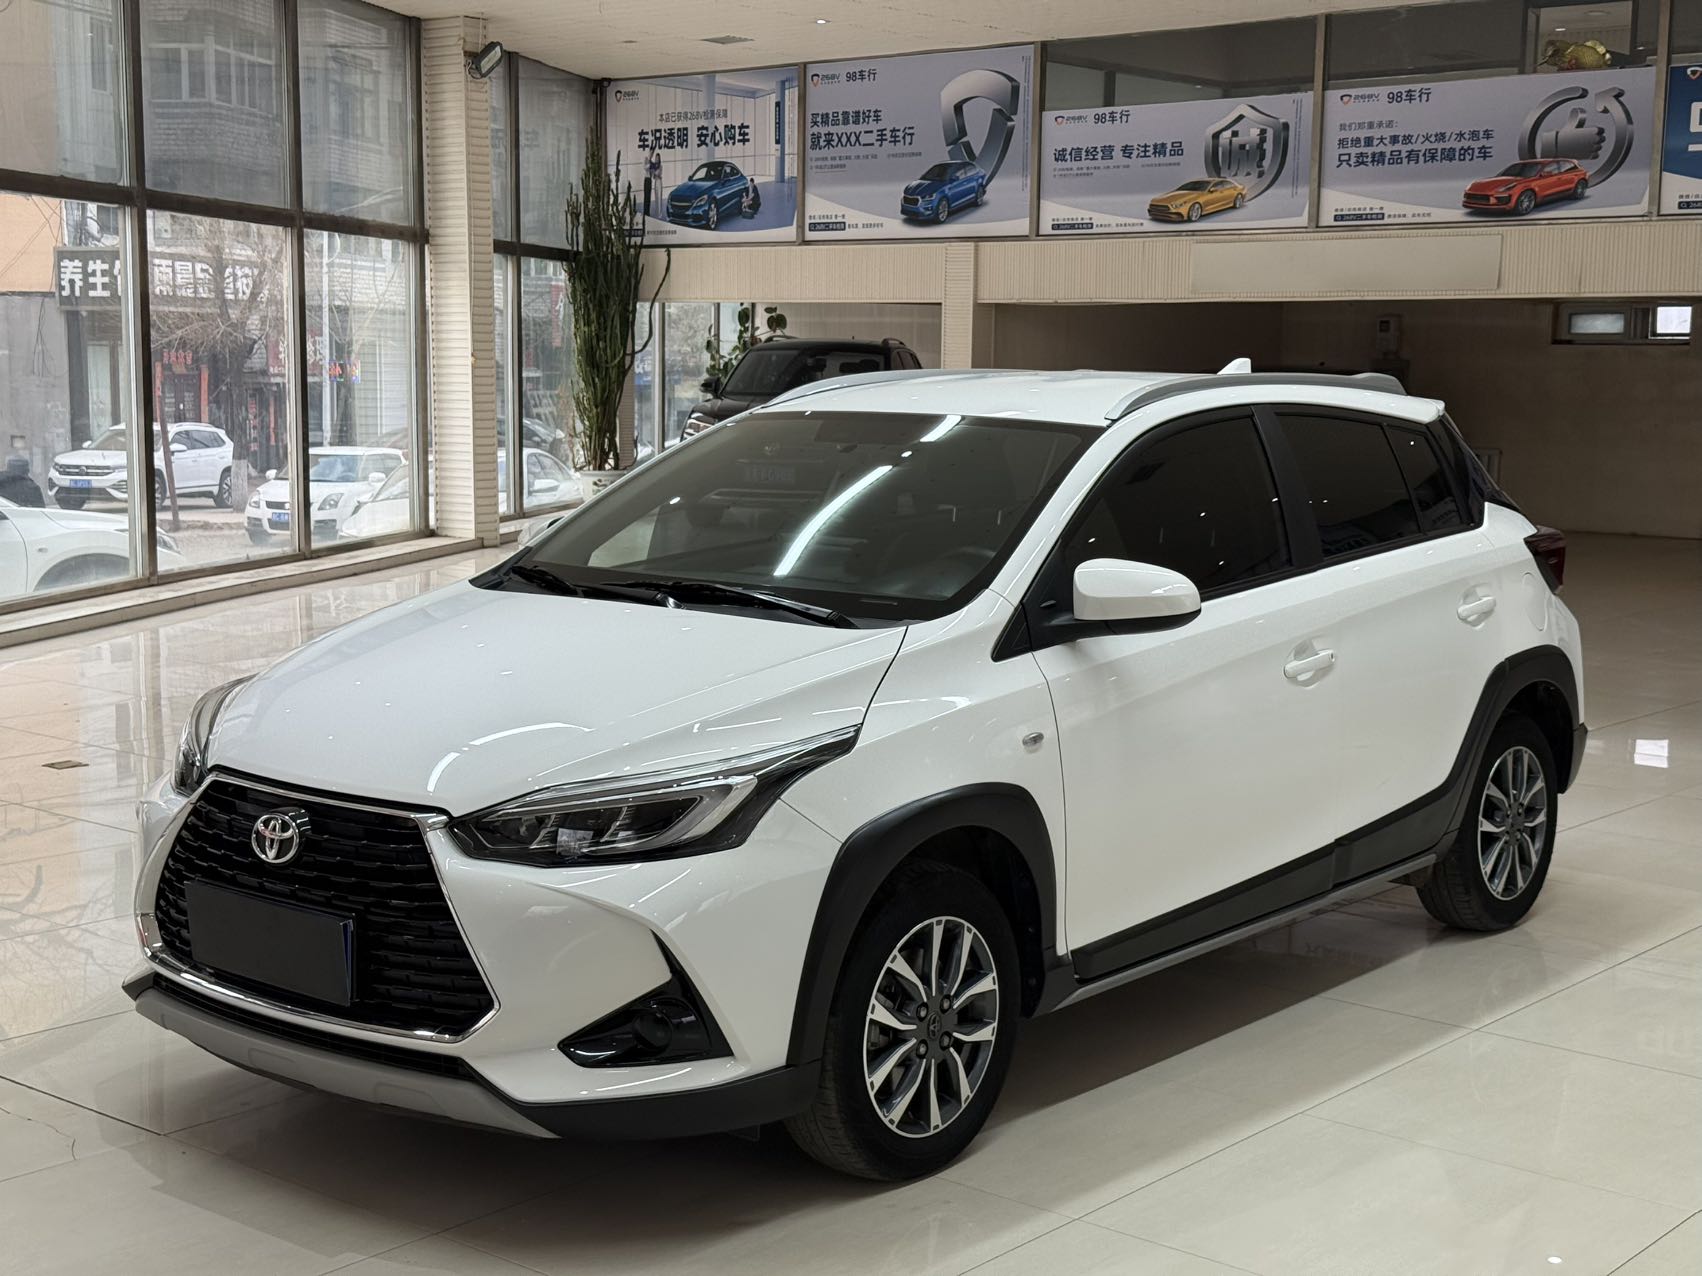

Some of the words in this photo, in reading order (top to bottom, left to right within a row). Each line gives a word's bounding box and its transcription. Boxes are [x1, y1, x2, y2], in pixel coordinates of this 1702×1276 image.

[820, 73, 841, 82] 268V
[845, 68, 877, 83] 98车行
[1387, 87, 1432, 104] 98车行
[809, 108, 882, 129] 买精品靠谱好车
[1093, 109, 1131, 125] 98车行
[637, 127, 689, 152] 车况透明
[696, 122, 751, 149] 安心购车
[809, 126, 915, 151] 就来XXX二手车行
[1337, 128, 1495, 150] 拒绝重大事故/火烧/水泡车
[1053, 144, 1116, 164] 诚信经营
[1120, 140, 1184, 160] 专注精品
[1336, 144, 1493, 169] 只卖精品有保障的车
